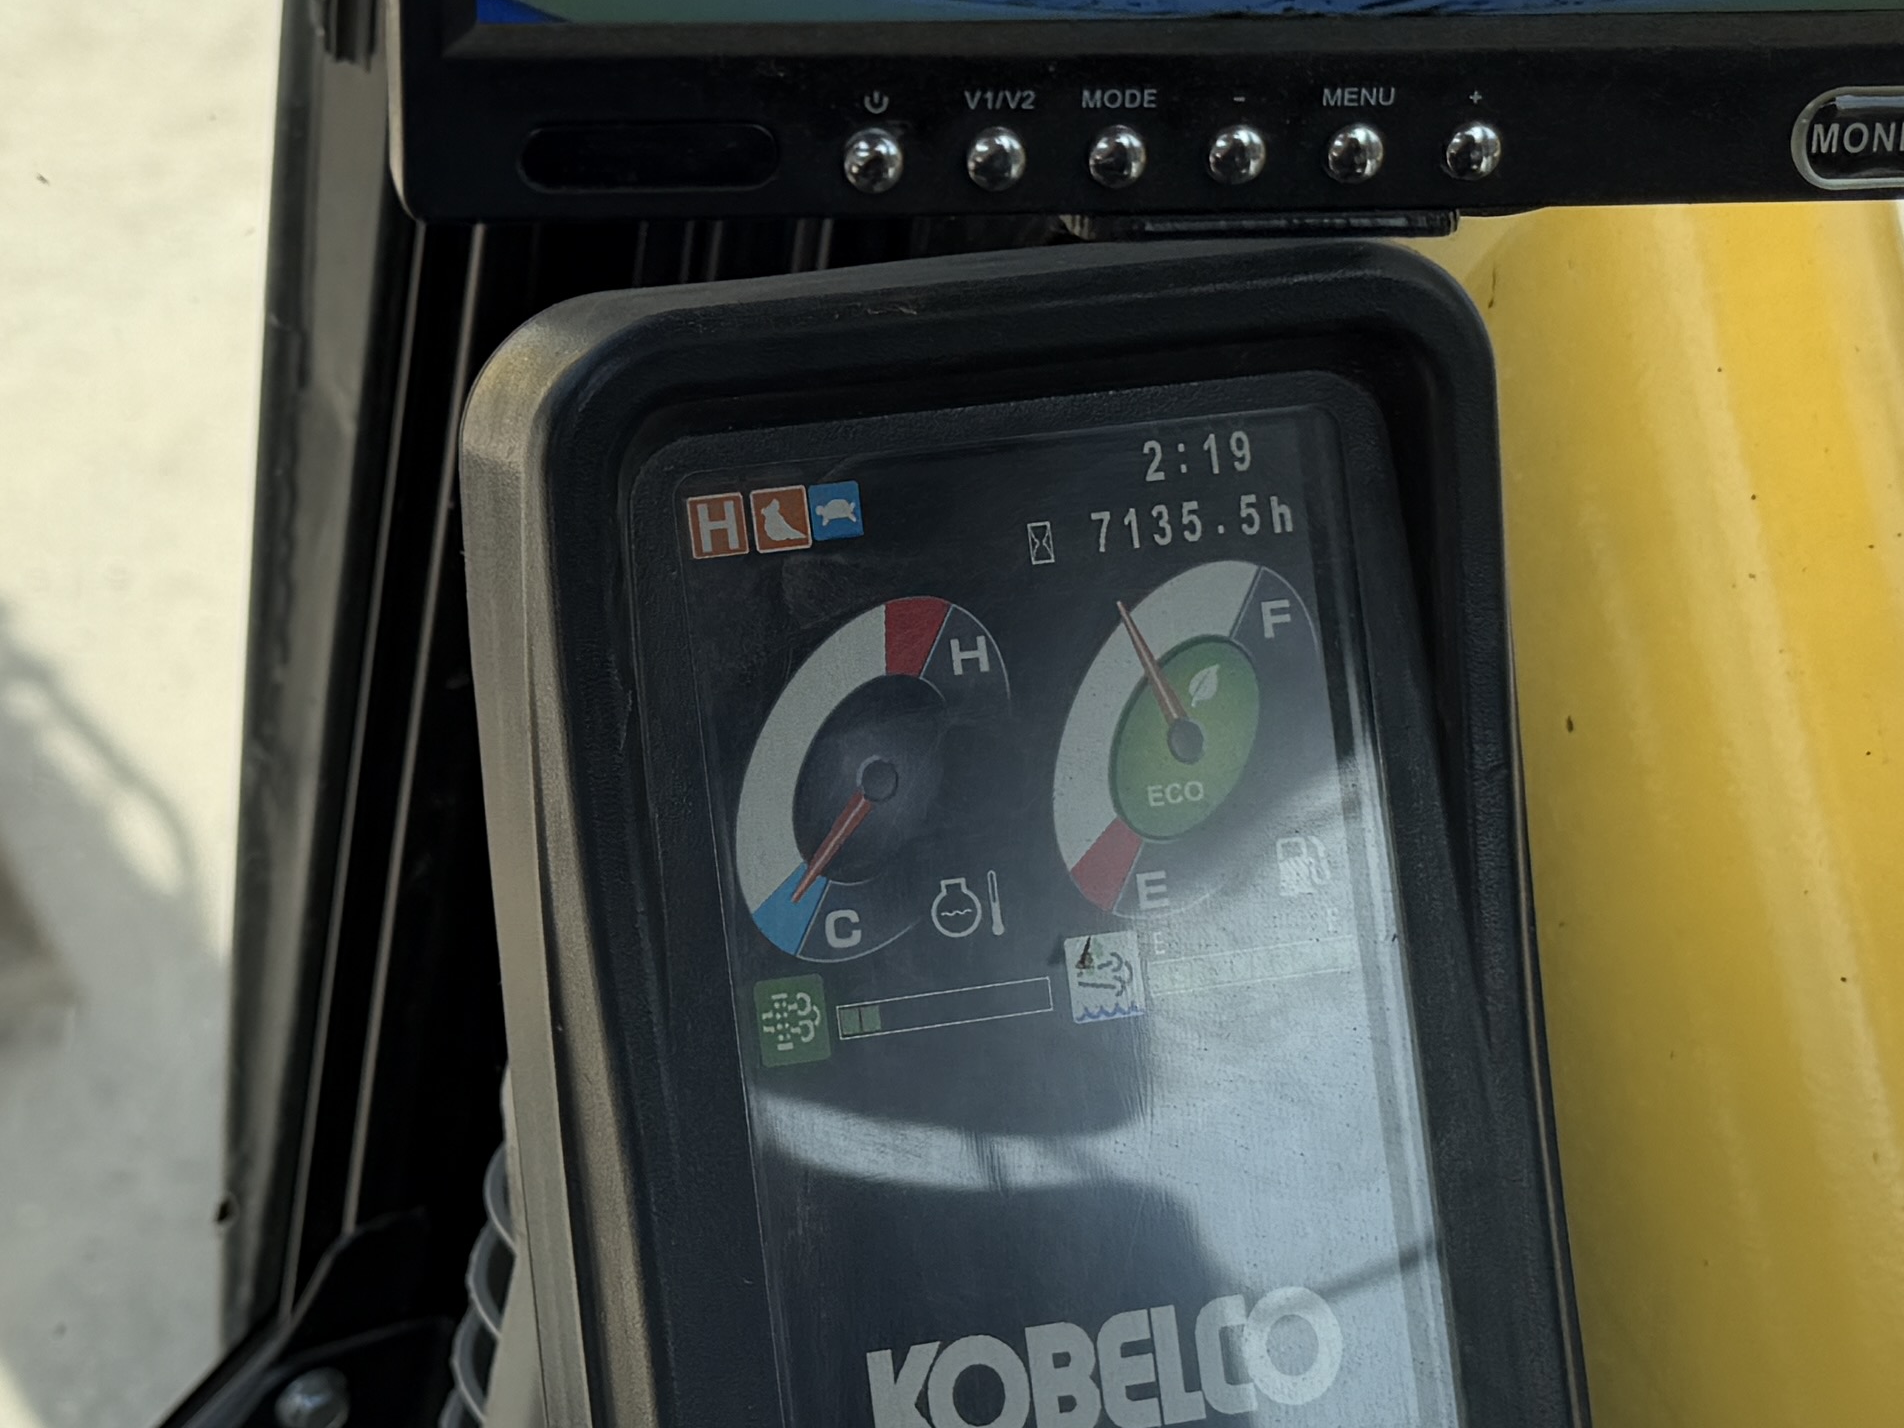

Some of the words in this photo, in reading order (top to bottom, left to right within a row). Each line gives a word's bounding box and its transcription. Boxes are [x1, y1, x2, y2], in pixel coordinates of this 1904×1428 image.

[964, 89, 1036, 110] V1/V2
[1081, 88, 1157, 109] MODE
[1322, 86, 1396, 107] MENU
[1142, 430, 1252, 482] 2:19
[696, 499, 740, 554] H
[1260, 599, 1293, 638] F
[949, 634, 990, 677] H
[1146, 780, 1205, 809] ECO
[1136, 870, 1170, 910] E
[824, 909, 863, 950] C
